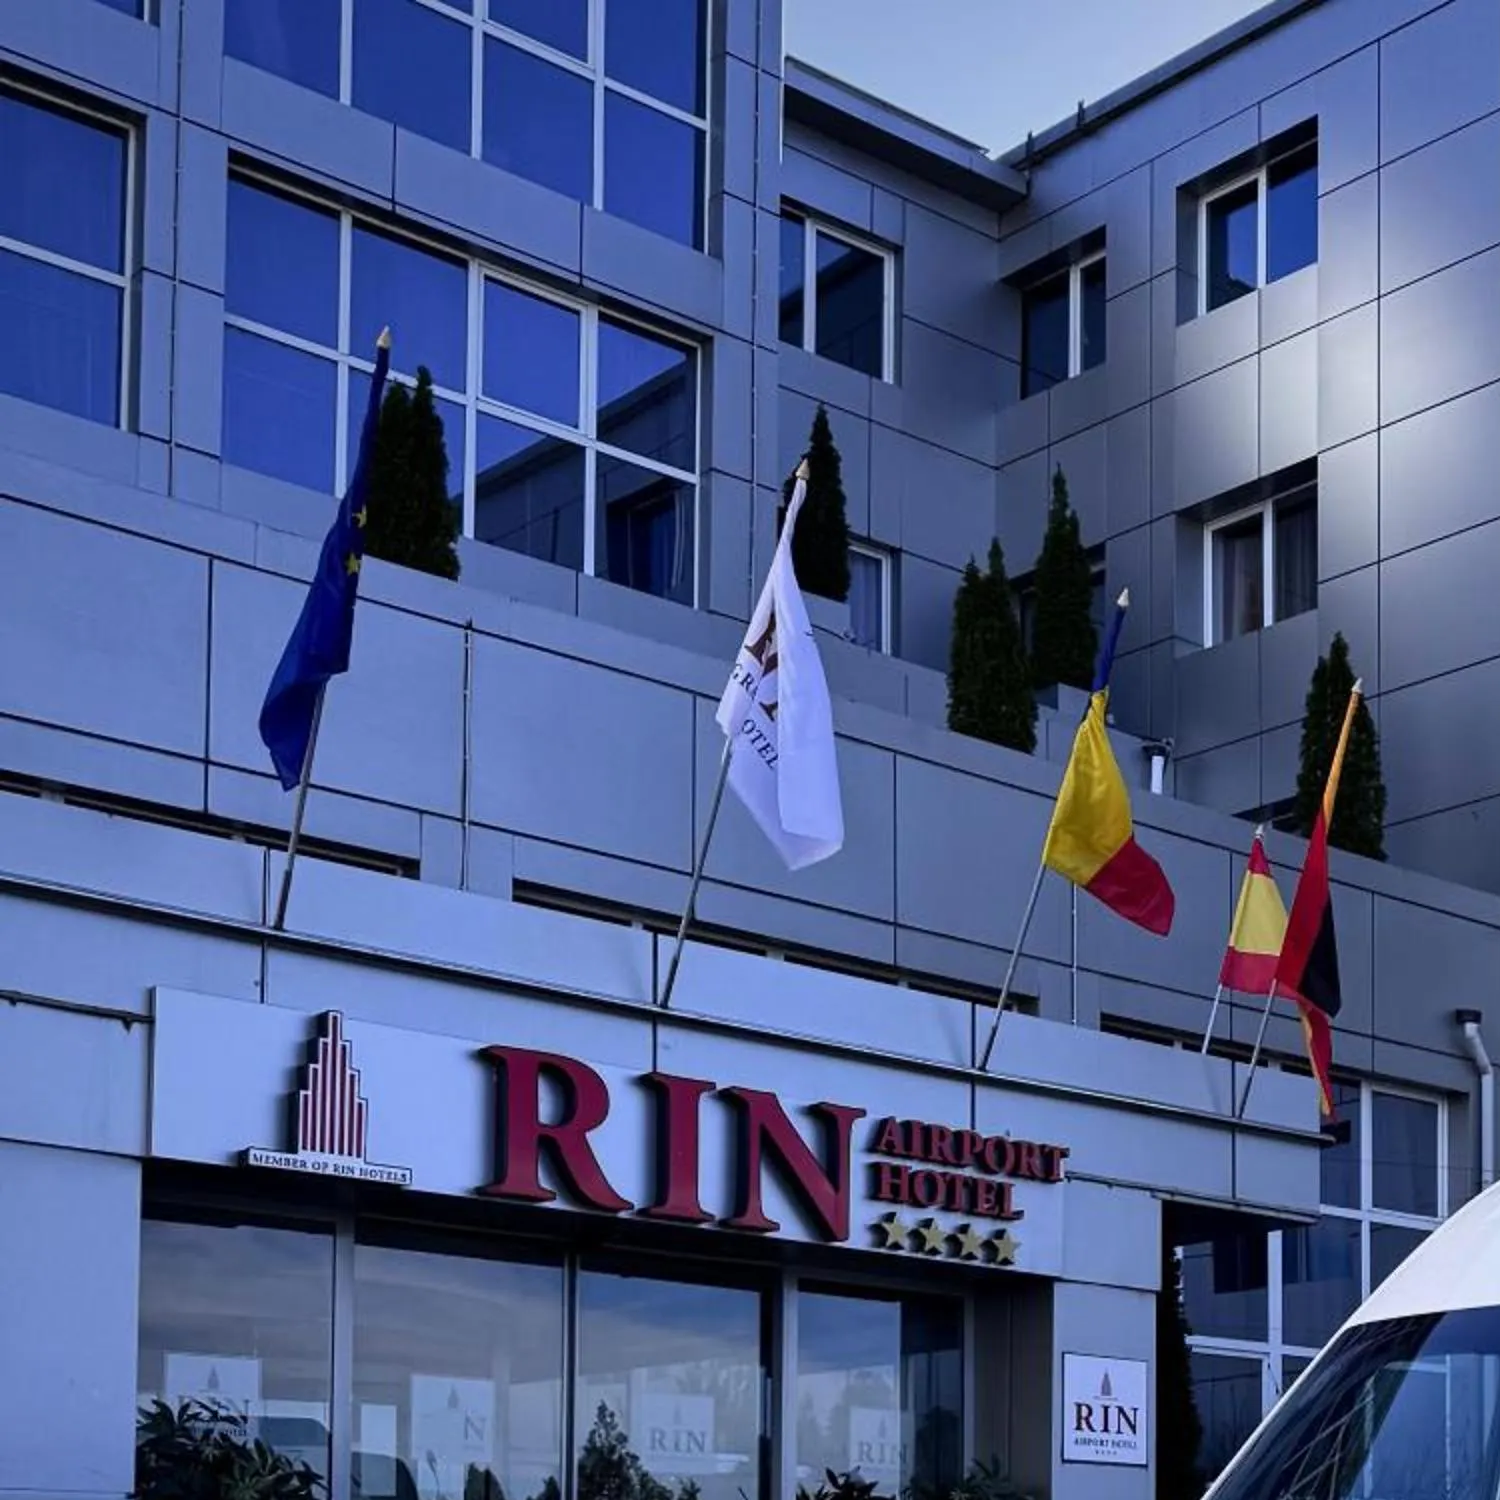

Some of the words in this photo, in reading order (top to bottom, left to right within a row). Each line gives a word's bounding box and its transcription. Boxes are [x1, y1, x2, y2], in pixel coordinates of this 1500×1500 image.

[740, 719, 778, 770] OTEL
[252, 1153, 307, 1168] MEMBER
[333, 1163, 355, 1175] RIN
[359, 1168, 407, 1182] HOTELS
[478, 1045, 867, 1242] RIN
[872, 1116, 1070, 1184] AIRPORT
[872, 1162, 1024, 1221] HOTEL
[649, 1427, 706, 1453] RIN
[1074, 1401, 1139, 1435] RIN
